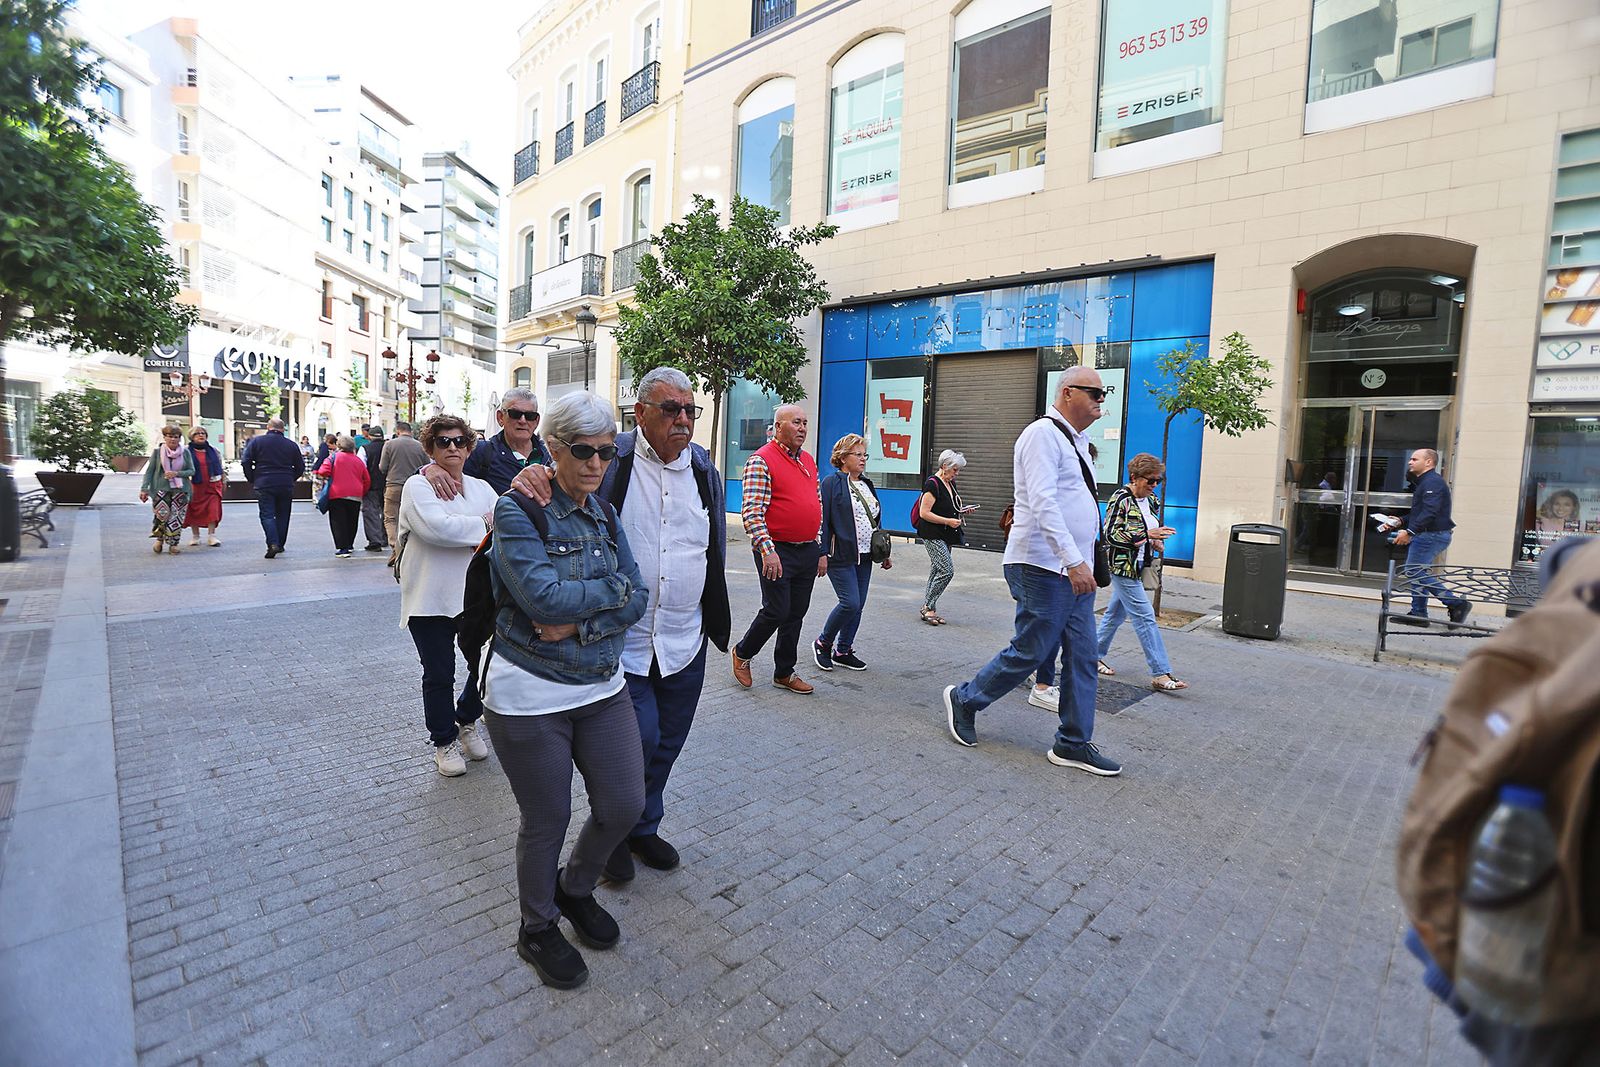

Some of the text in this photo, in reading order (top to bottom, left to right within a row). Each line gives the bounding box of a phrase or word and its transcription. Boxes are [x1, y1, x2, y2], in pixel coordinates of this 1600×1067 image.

[1119, 16, 1208, 59] 963 53 13 39
[855, 116, 894, 141] ALQUILA
